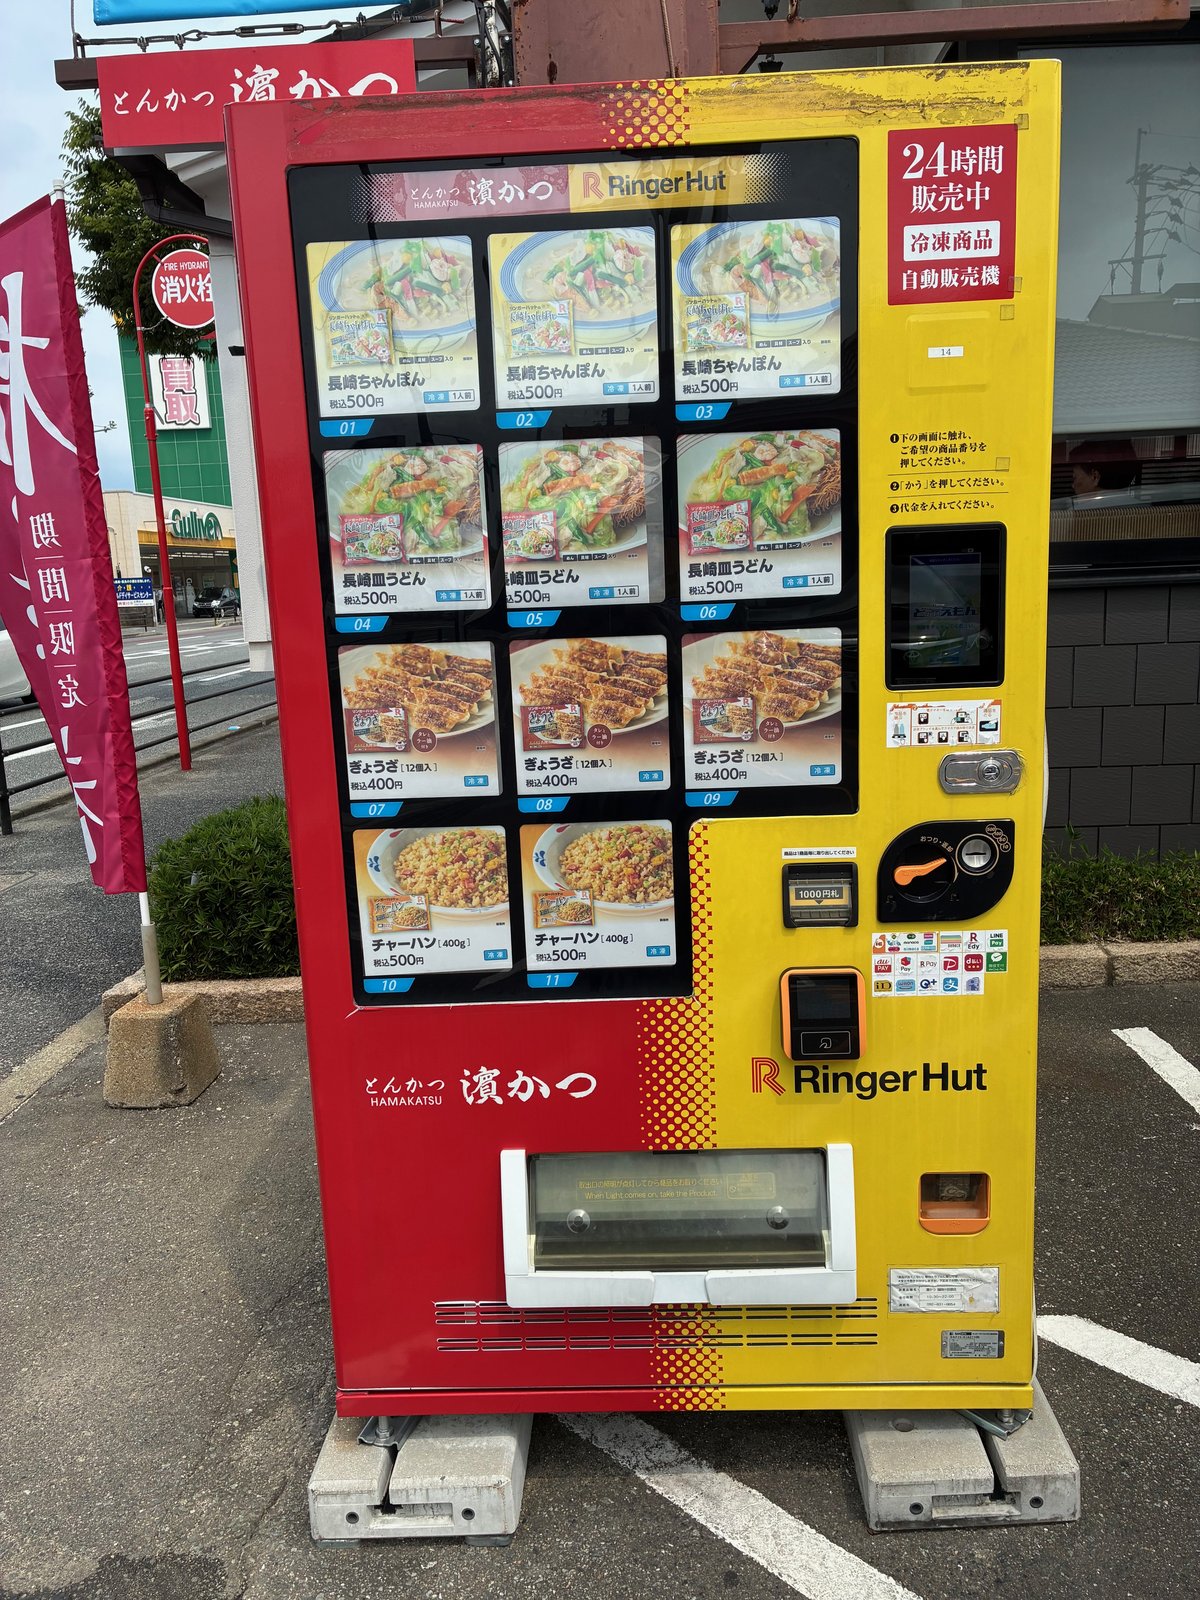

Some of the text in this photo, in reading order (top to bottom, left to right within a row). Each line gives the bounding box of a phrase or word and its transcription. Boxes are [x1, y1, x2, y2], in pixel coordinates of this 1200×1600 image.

[113, 88, 215, 115] とんかつ
[902, 141, 1004, 179] 24時間
[608, 173, 684, 198] Ringer
[686, 169, 727, 192] Hut
[410, 179, 554, 206] とんかつ 濱かつ
[910, 181, 991, 214] 販売中
[413, 200, 459, 209] HAMAKATSU
[910, 228, 993, 254] 冷凍商品
[164, 261, 208, 271] FIRE HYDRANT
[902, 265, 1000, 291] 自動販売機
[160, 272, 214, 304] 消火栓
[940, 348, 952, 356] 14
[506, 362, 606, 382] 長崎ちゃんぽん
[682, 356, 782, 376] 長崎ちゃんぽん
[328, 372, 426, 391] 長崎ちゃんぽん
[682, 378, 739, 394] 税込500円
[808, 376, 828, 384] 1人前
[160, 358, 200, 426] 買取
[508, 386, 562, 400] 税込500円
[632, 384, 652, 392] 1人前
[330, 394, 384, 409] 税込500円
[452, 392, 472, 400] 1人前
[695, 406, 714, 419] 03
[516, 414, 534, 427] 02
[340, 422, 356, 435] 01
[900, 442, 987, 454] ご希望の商品番号を
[900, 457, 966, 468] 押してください。
[688, 559, 774, 578] 長崎皿うどん
[342, 572, 426, 588] 長崎皿うどん
[688, 580, 743, 595] 税込500円
[344, 591, 398, 606] 税込500円
[506, 590, 550, 604] 込500円
[526, 612, 543, 625] 05
[700, 606, 717, 619] 06
[354, 618, 371, 631] 04
[524, 756, 574, 771] ぎょうざ
[694, 749, 744, 765] ぎょうざ
[349, 759, 399, 774] ぎょうざ
[526, 775, 578, 788] 税込400円
[694, 768, 747, 781] 税込400円
[350, 777, 403, 791] 税込400円
[536, 798, 553, 811] 08
[703, 793, 721, 805] 09
[368, 804, 385, 816] 07
[799, 890, 840, 898] 1000円札
[372, 937, 436, 952] チャーハン
[535, 932, 600, 946] チャーハン
[373, 954, 424, 968] 税込500円
[536, 949, 586, 962] 税込500円
[382, 980, 397, 991] 10
[546, 974, 560, 986] 11
[365, 1065, 597, 1106] とんかつ 濱かつ
[794, 1064, 917, 1101] Ringer
[922, 1062, 988, 1092] Hut
[370, 1096, 442, 1107] HAMAKATSU
